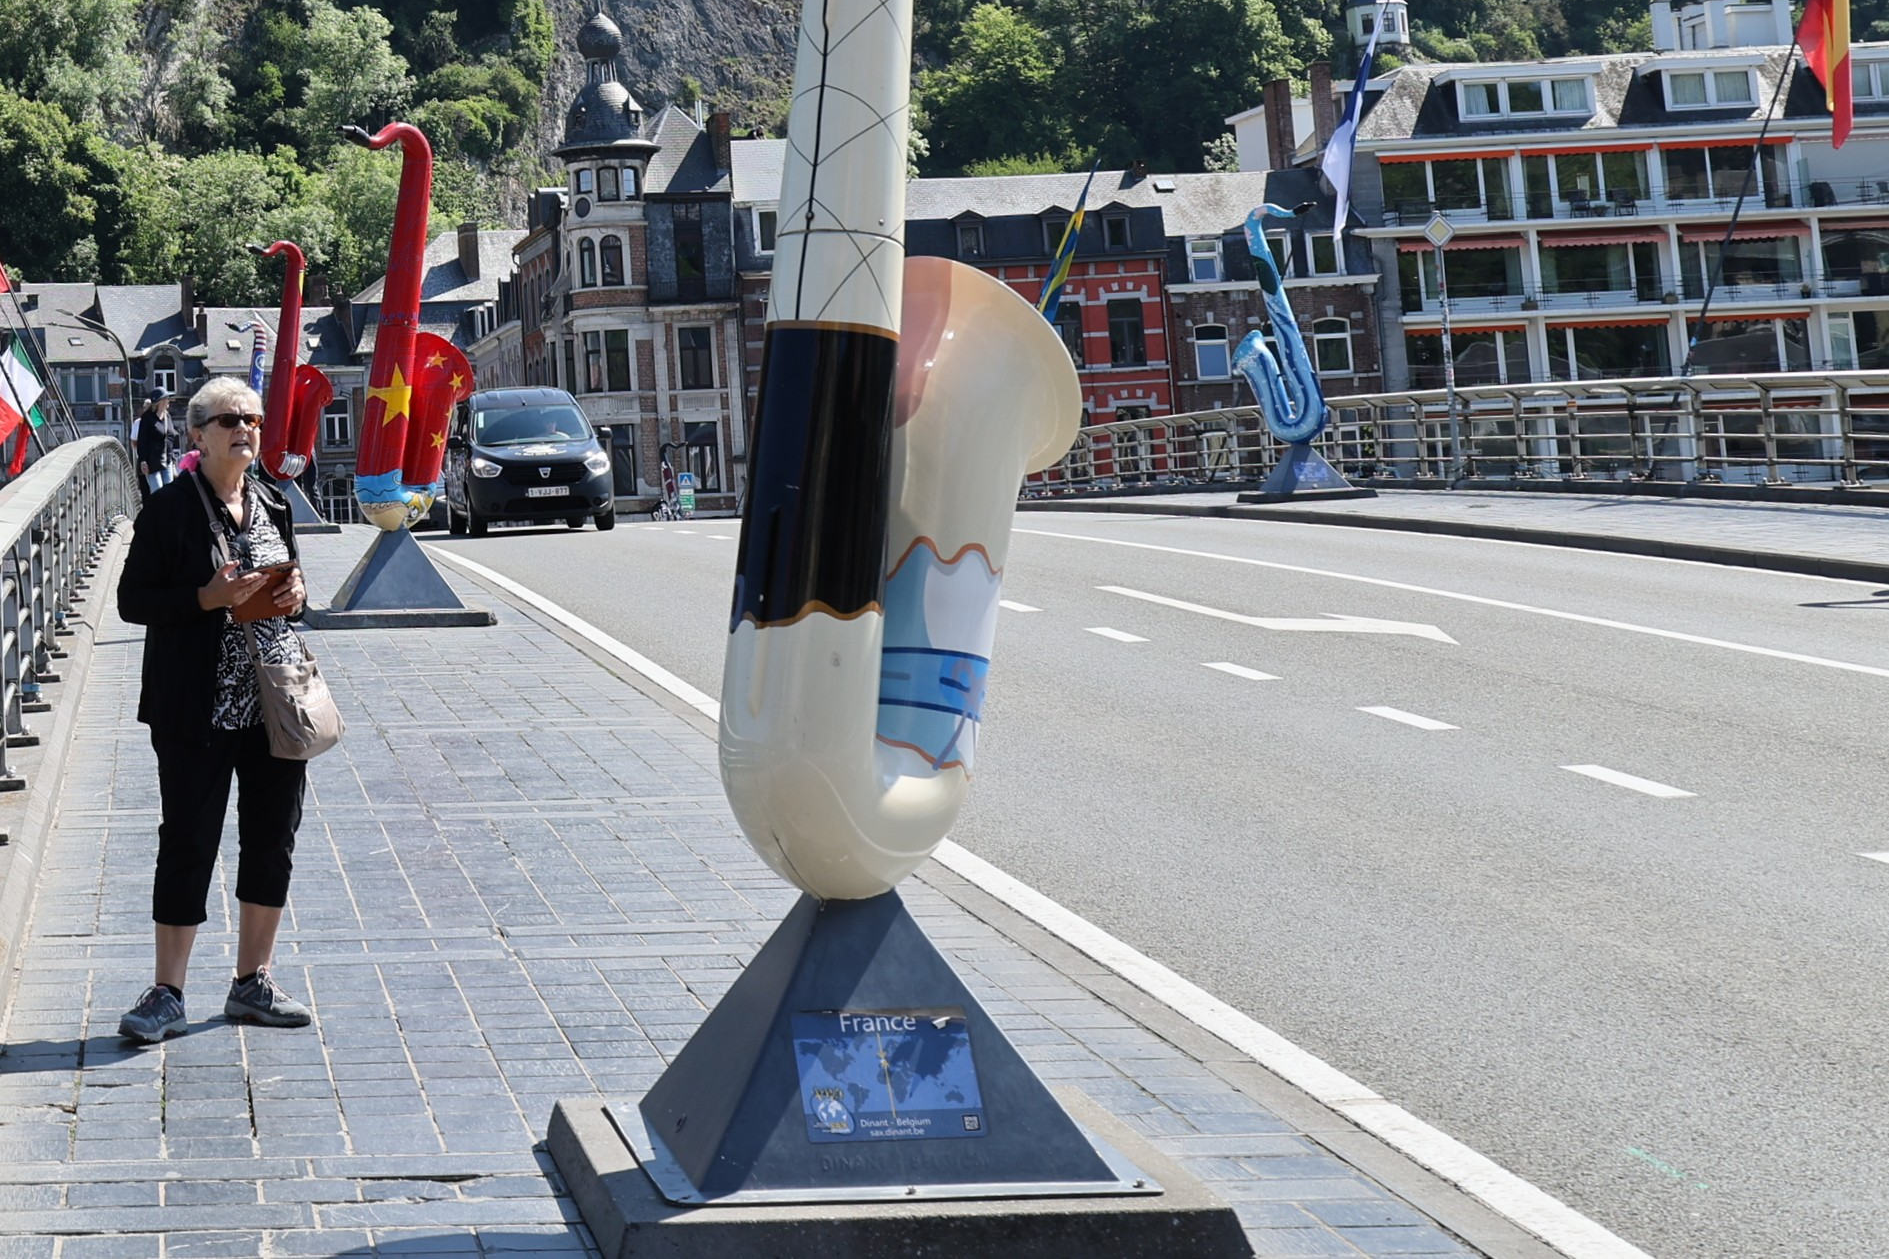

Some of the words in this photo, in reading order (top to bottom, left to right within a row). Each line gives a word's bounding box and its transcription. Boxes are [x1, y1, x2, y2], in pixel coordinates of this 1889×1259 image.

[839, 1013, 916, 1032] France
[860, 1118, 889, 1127] Dinant
[896, 1117, 931, 1127] Belgium
[870, 1127, 925, 1136] sax.dinant.be
